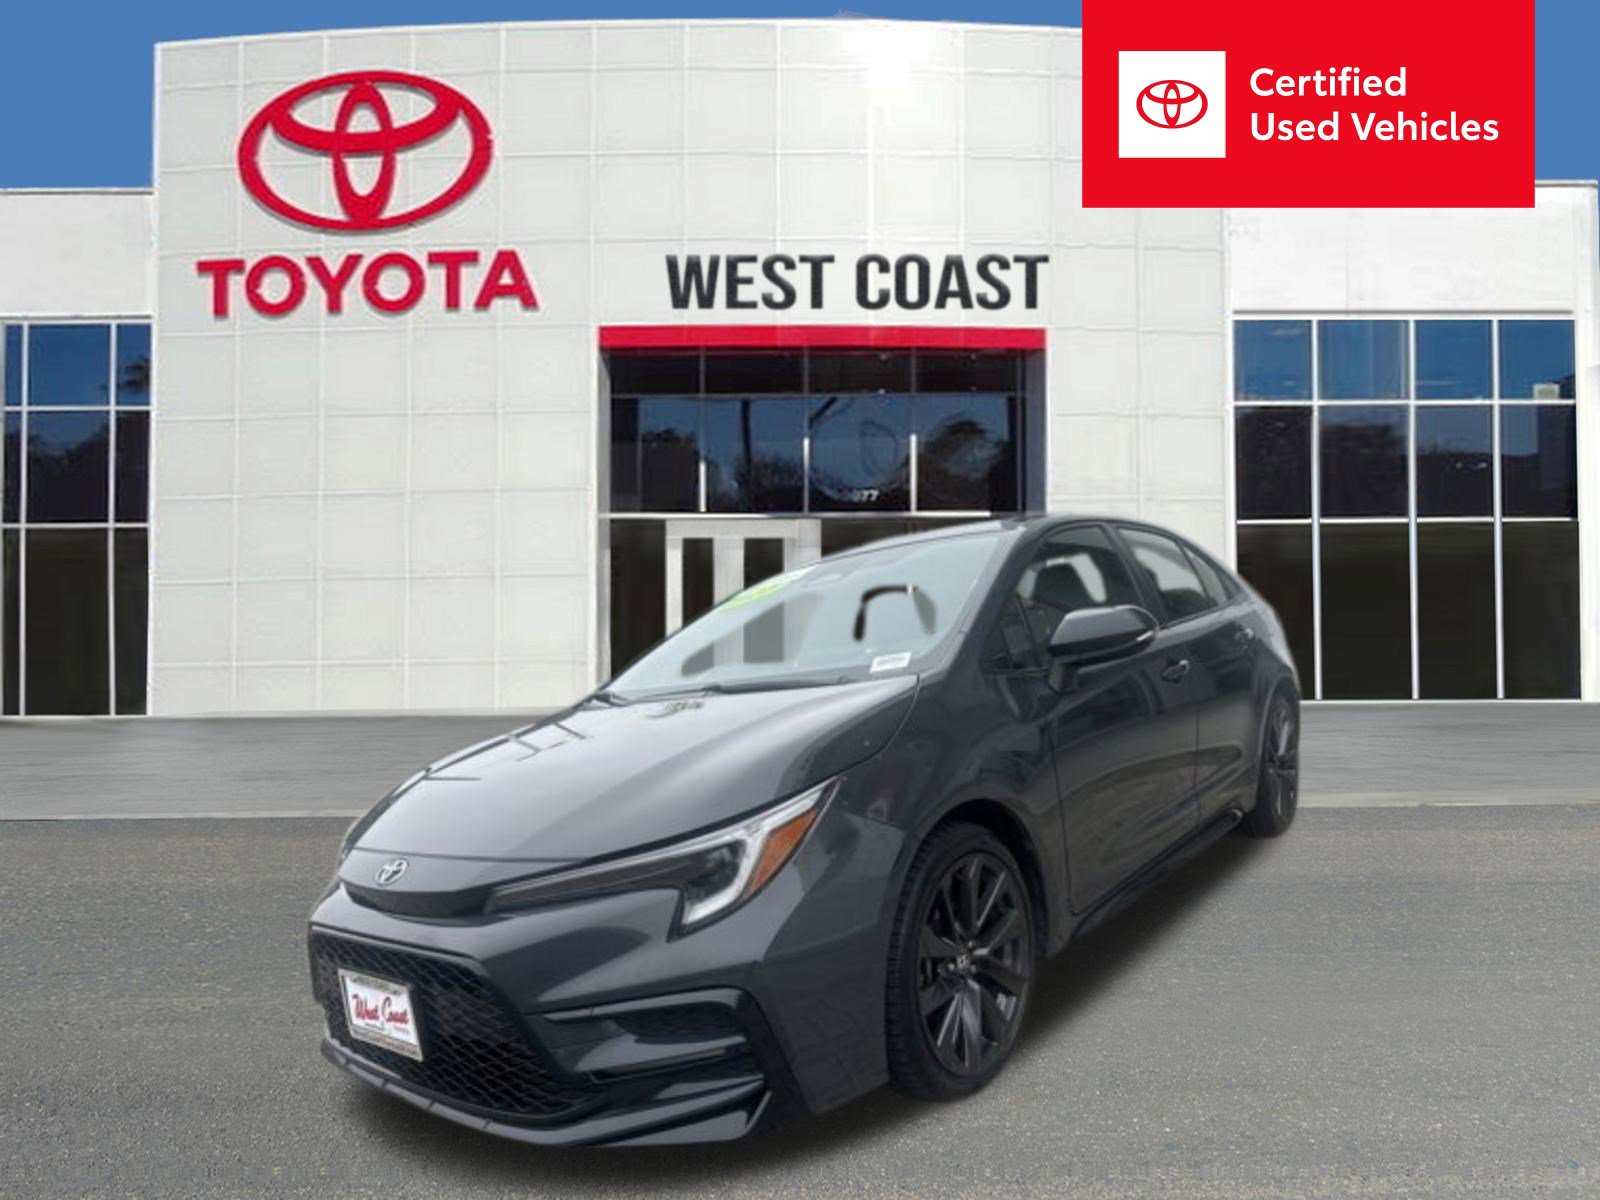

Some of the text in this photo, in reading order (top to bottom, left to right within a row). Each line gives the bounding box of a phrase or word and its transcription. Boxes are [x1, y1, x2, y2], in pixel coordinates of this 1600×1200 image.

[196, 249, 538, 317] TOYOTA
[666, 255, 1049, 310] WEST COAST
[352, 993, 409, 1024] West Coast
